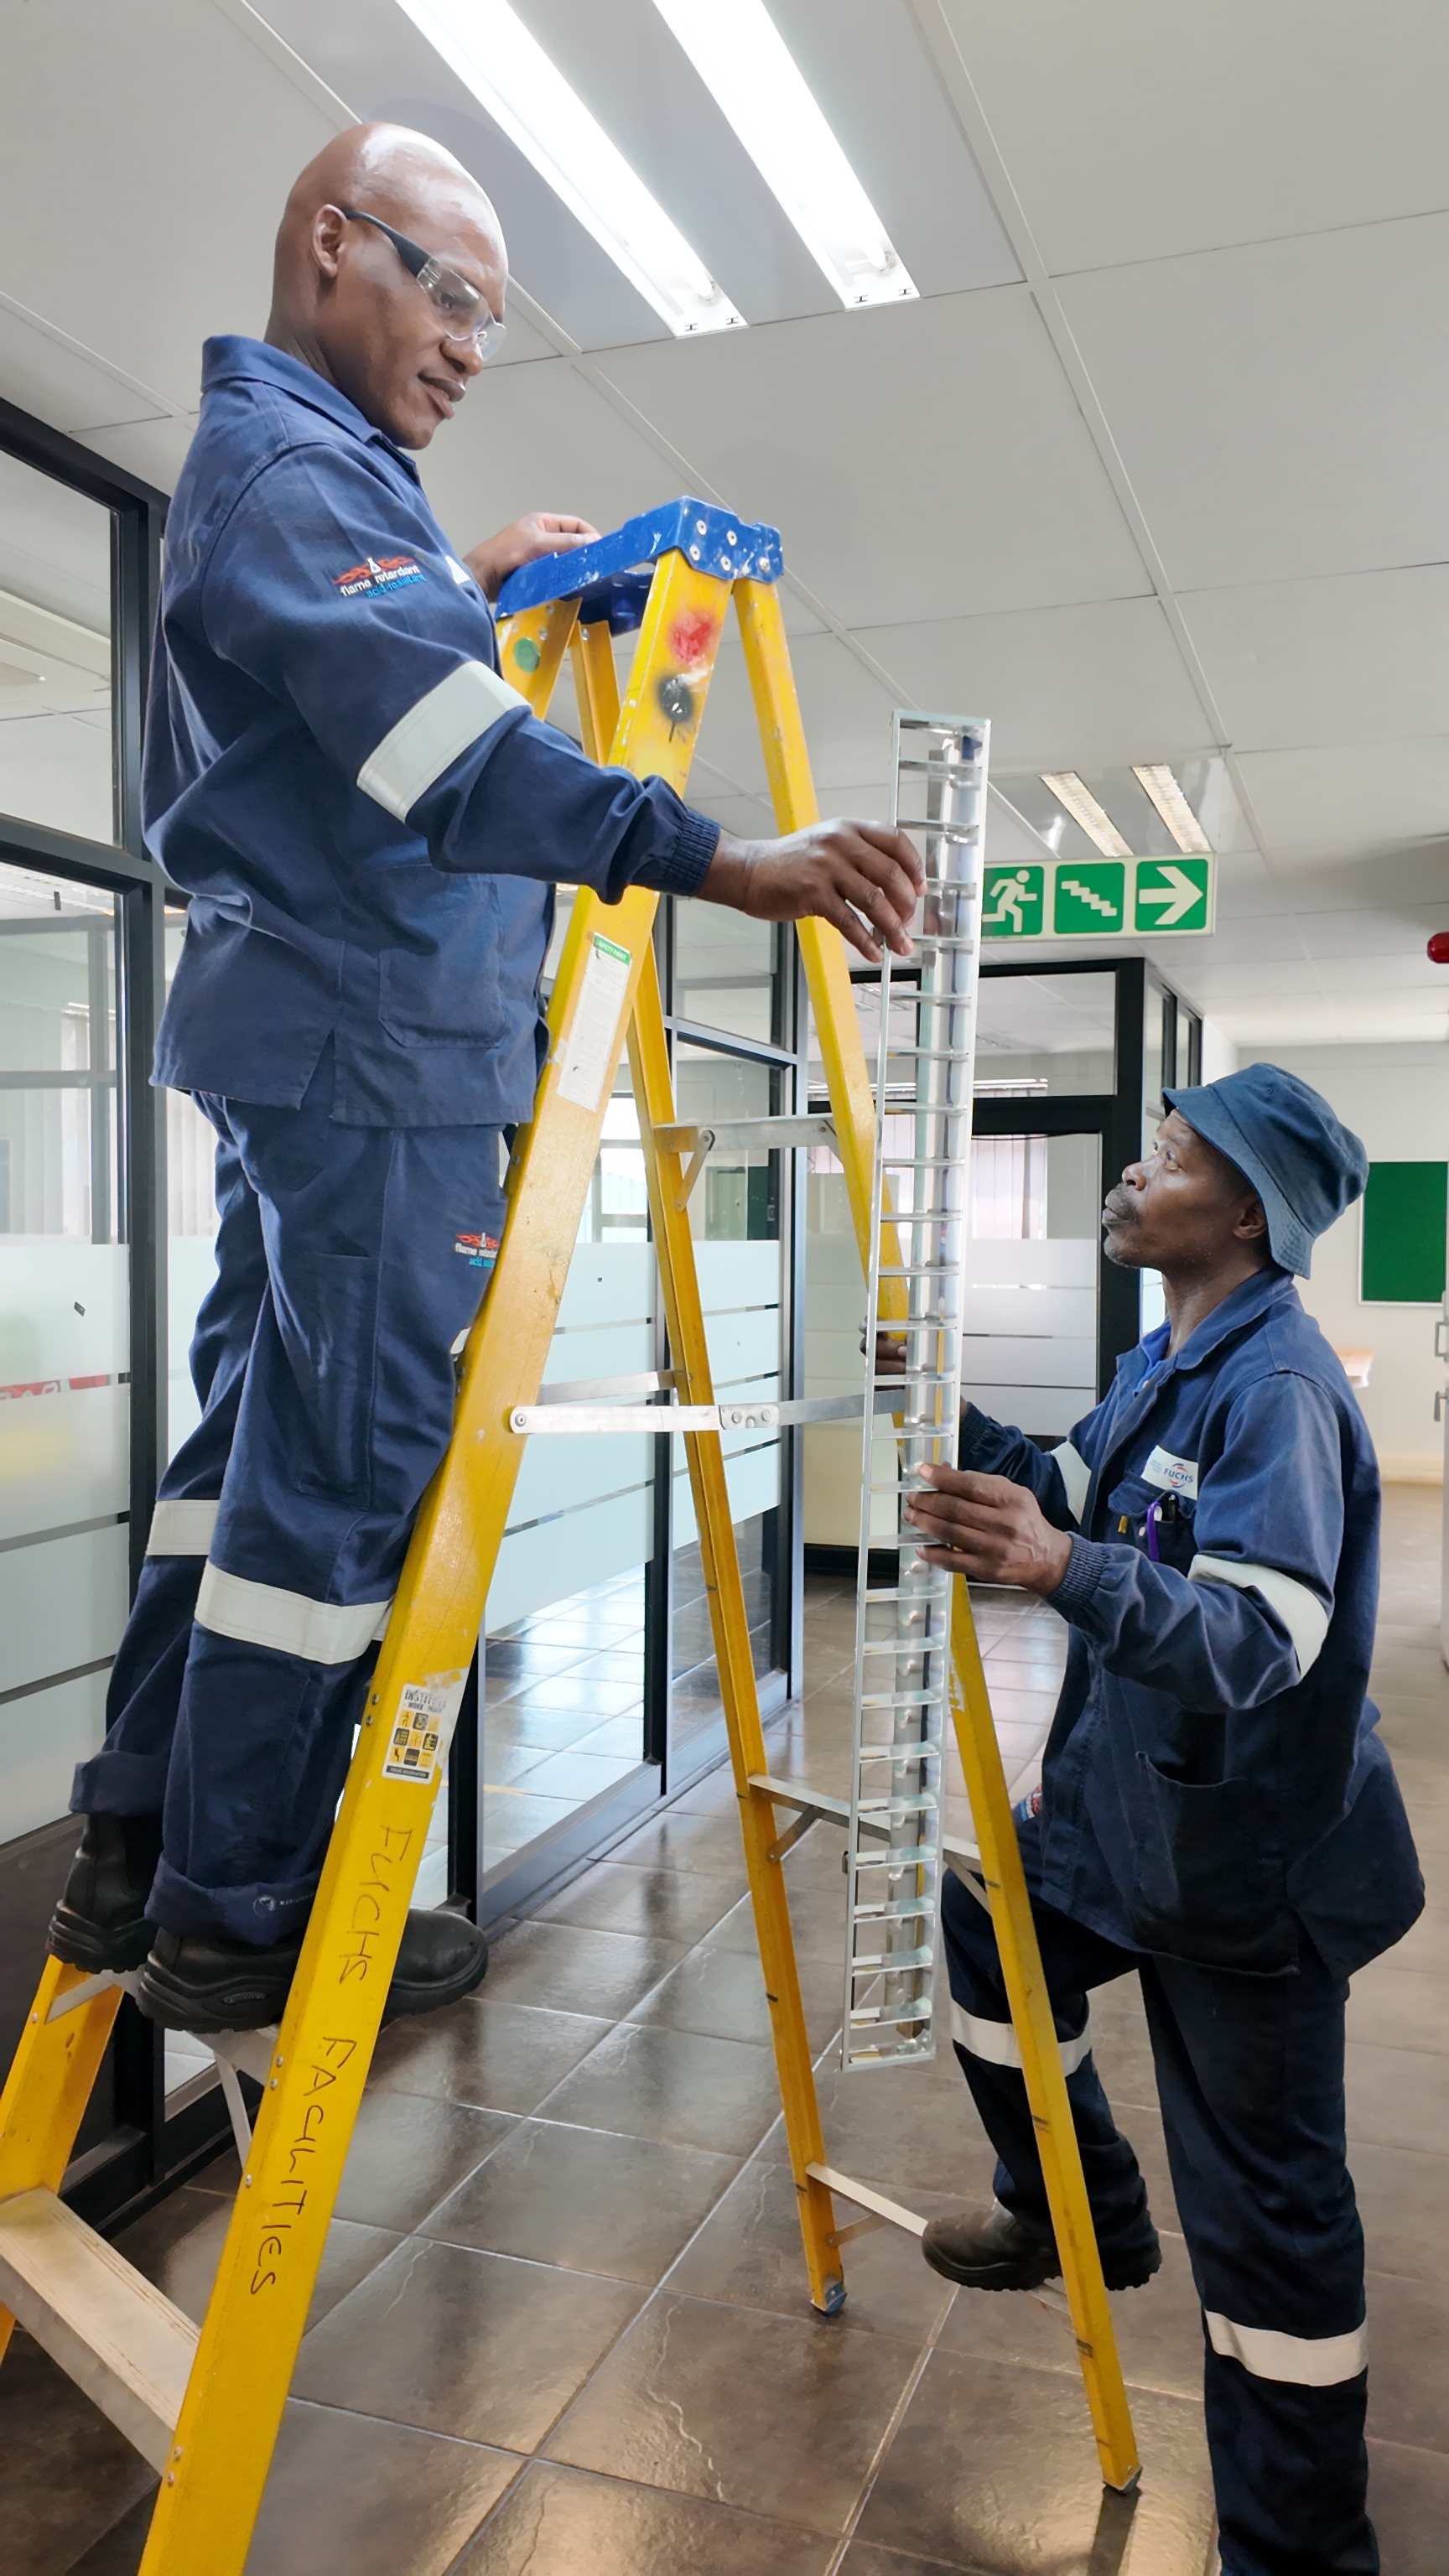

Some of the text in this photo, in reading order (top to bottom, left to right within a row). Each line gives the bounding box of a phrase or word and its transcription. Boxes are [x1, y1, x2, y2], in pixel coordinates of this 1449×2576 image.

[1164, 1467, 1193, 1483] FUCHS
[250, 1825, 413, 2295] FUCHS FACILITIES
